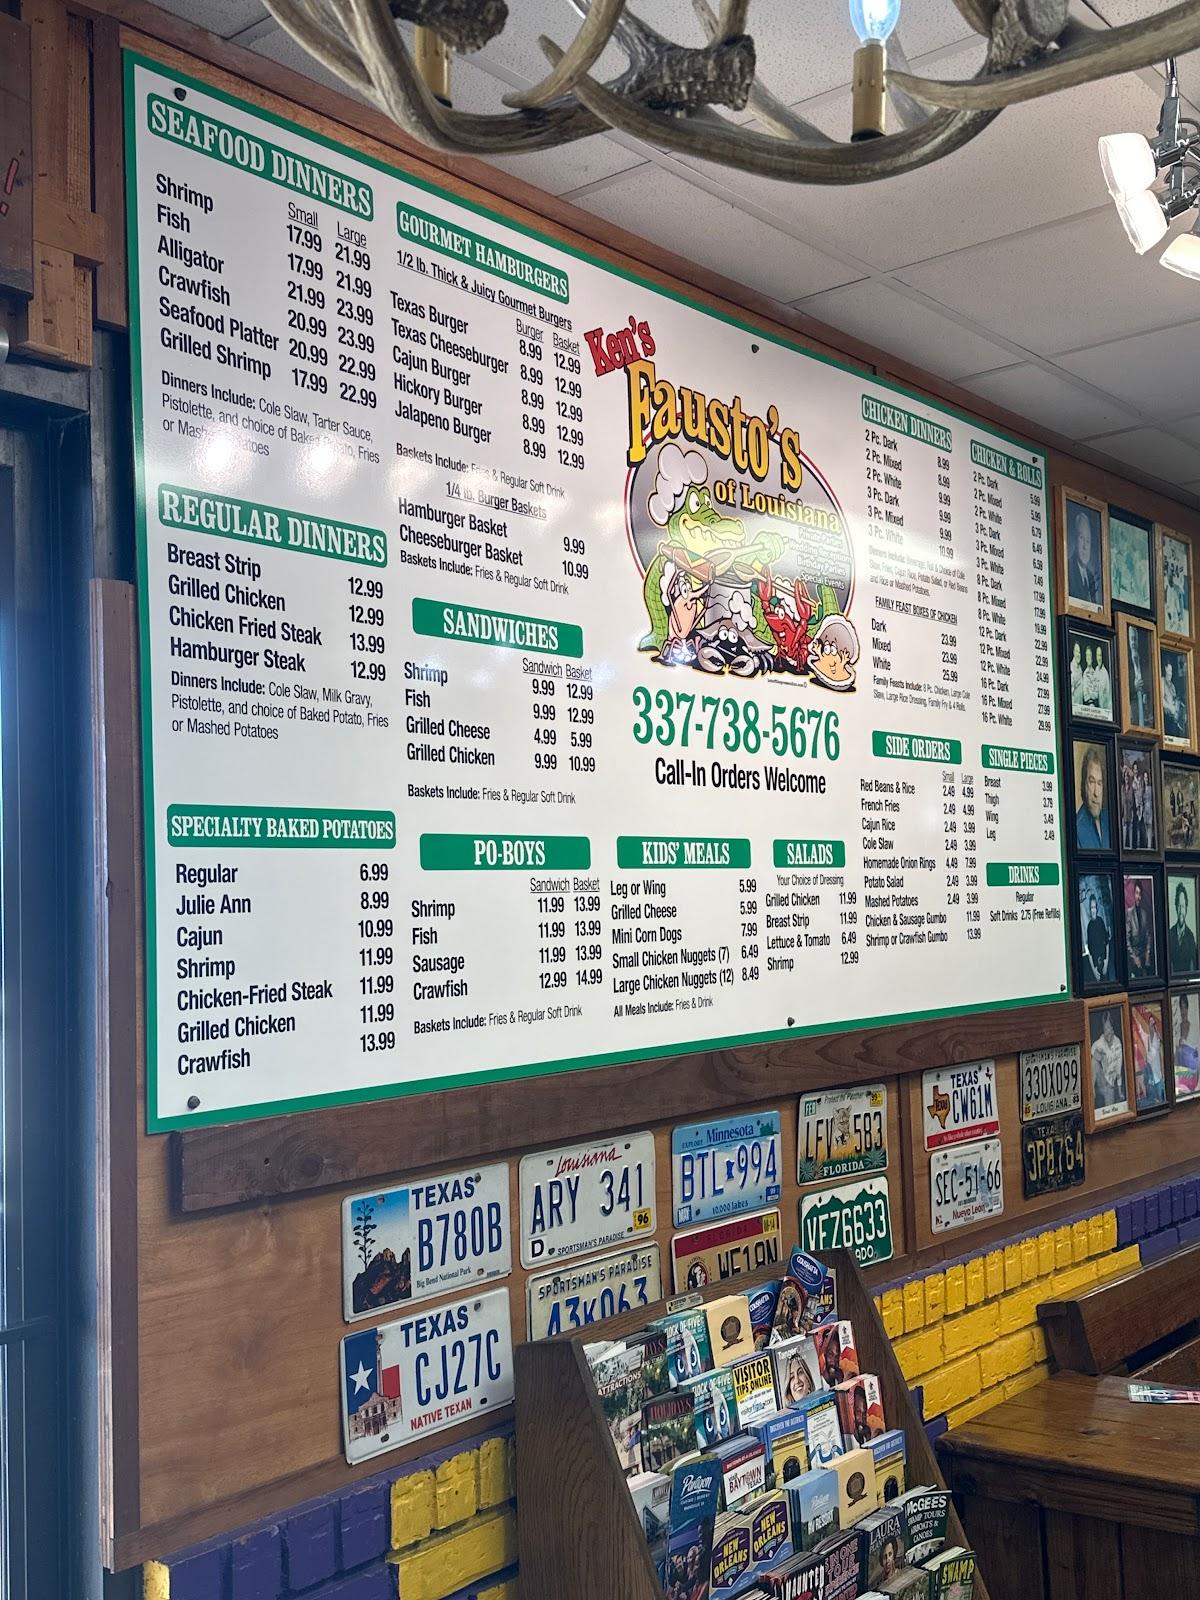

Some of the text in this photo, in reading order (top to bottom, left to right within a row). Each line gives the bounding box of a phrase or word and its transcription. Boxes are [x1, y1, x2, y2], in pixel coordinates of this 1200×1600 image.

[149, 100, 371, 217] SEAFOOD DINNERS
[156, 173, 371, 271] Shrimp 17.99 21.99
[288, 201, 367, 250] Small Large
[399, 210, 569, 298] GOURMET HAMBURGERS
[397, 250, 573, 332] 1/2 lb. Thick & Juicy Gourmet Burgers
[159, 296, 376, 382] Seafood Platter 20.99 22.99
[584, 315, 657, 377] Ken's
[390, 317, 582, 399] Texas Cheeseburger 8.99 12.99
[625, 358, 803, 493] Fausto's
[862, 398, 952, 452] CHICKEN DINNERS
[971, 442, 1042, 488] CHICKEN & ROLLS
[713, 479, 841, 535] of Louisiana
[159, 489, 385, 563] REGULAR DINNERS
[443, 608, 559, 651] SANDWICHES
[936, 610, 958, 626] CHICKEN
[632, 686, 840, 761] 337-738-5676
[885, 735, 951, 761] SIDE ORDERS
[988, 748, 1048, 772] SINGLE PIECES
[655, 757, 826, 795] Call-In Orders Welcome
[860, 778, 974, 799] Red Beans & Rice 2.49 4.99
[984, 775, 1002, 788] Breast
[171, 815, 394, 840] SPECIALTY BAKED POTATOES
[473, 839, 546, 866] PO-BOYS
[642, 841, 730, 865] KIDS' MEALS
[786, 842, 834, 865] SALADS
[1008, 865, 1040, 884] DRINKS
[1015, 891, 1035, 905] Regular
[865, 910, 981, 928] Chicken & Sausage Gumbo 11.99
[1020, 909, 1032, 921] 2.75
[766, 931, 857, 950] Lettuce & Tomato 6.49
[412, 944, 602, 974] Sausage 11.99 13.99
[613, 966, 760, 996] Large Chicken Nuggets (12) 8.49
[951, 1070, 979, 1089] TEXAS
[1025, 1059, 1078, 1102] 330X099
[952, 1083, 993, 1124] CW61M
[706, 1123, 754, 1144] Minnesota
[854, 1111, 883, 1153] 583
[555, 1144, 622, 1178] Louisiana
[681, 1137, 777, 1203] BTL 994
[823, 1160, 865, 1177] FLORIDA
[412, 1176, 475, 1210] TEXAS
[936, 1159, 1001, 1207] SEC-51-66
[531, 1162, 643, 1235] ARY 341
[731, 1199, 749, 1211] lakes
[637, 1212, 649, 1225] 96
[418, 1202, 502, 1272] B780B
[531, 1239, 544, 1259] D
[557, 1231, 625, 1256] SPORTSMAN'S PARADISE
[417, 1266, 472, 1288] Big Bend National Park
[539, 1255, 652, 1301] SPORTSMAN'S PARADISE
[401, 1305, 469, 1348] TEXAS
[416, 1329, 501, 1406] CJ27C
[734, 1358, 771, 1385] VISITOR
[598, 1371, 641, 1395] ATTRACTIONS
[736, 1384, 749, 1401] TIPS
[749, 1374, 772, 1395] ONLINE
[411, 1398, 472, 1431] NATIVE TEXAN
[729, 1467, 762, 1493] BAYTOWN
[747, 1476, 762, 1488] TEXAS
[760, 1510, 776, 1529] NEW
[923, 1509, 946, 1520] TOURS
[754, 1522, 786, 1552] ORLEANS
[870, 1516, 901, 1543] LAURA
[723, 1537, 740, 1556] NEW
[714, 1549, 748, 1577] ORLEANS
[941, 1559, 975, 1585] SWAMP
